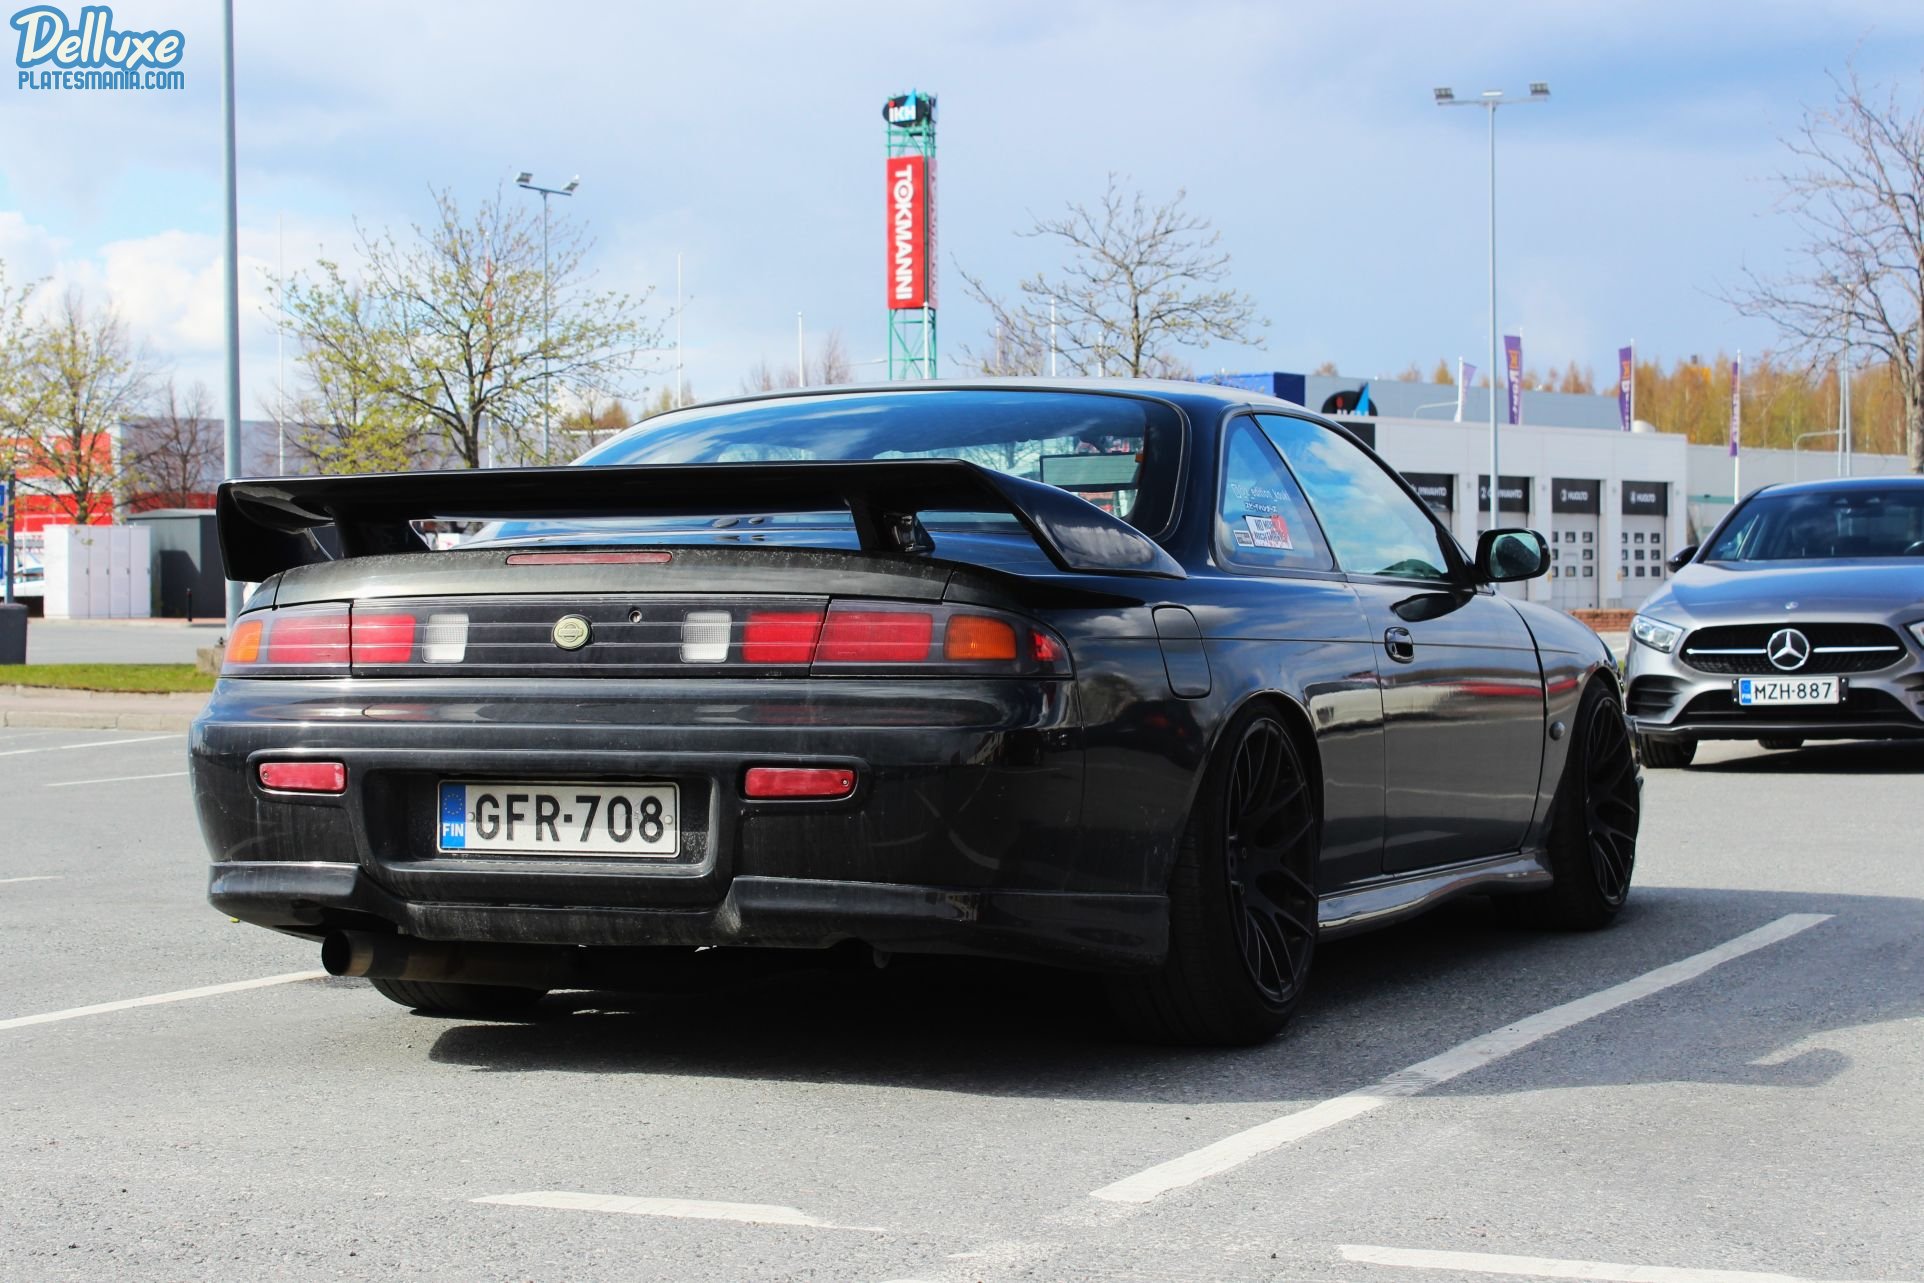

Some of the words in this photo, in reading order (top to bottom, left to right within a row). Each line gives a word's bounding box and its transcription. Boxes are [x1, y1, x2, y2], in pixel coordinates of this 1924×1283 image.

[893, 164, 914, 300] TOKMANNI
[1754, 683, 1832, 700] MZH-887
[442, 822, 464, 837] FIN
[475, 793, 664, 843] GFR-708
